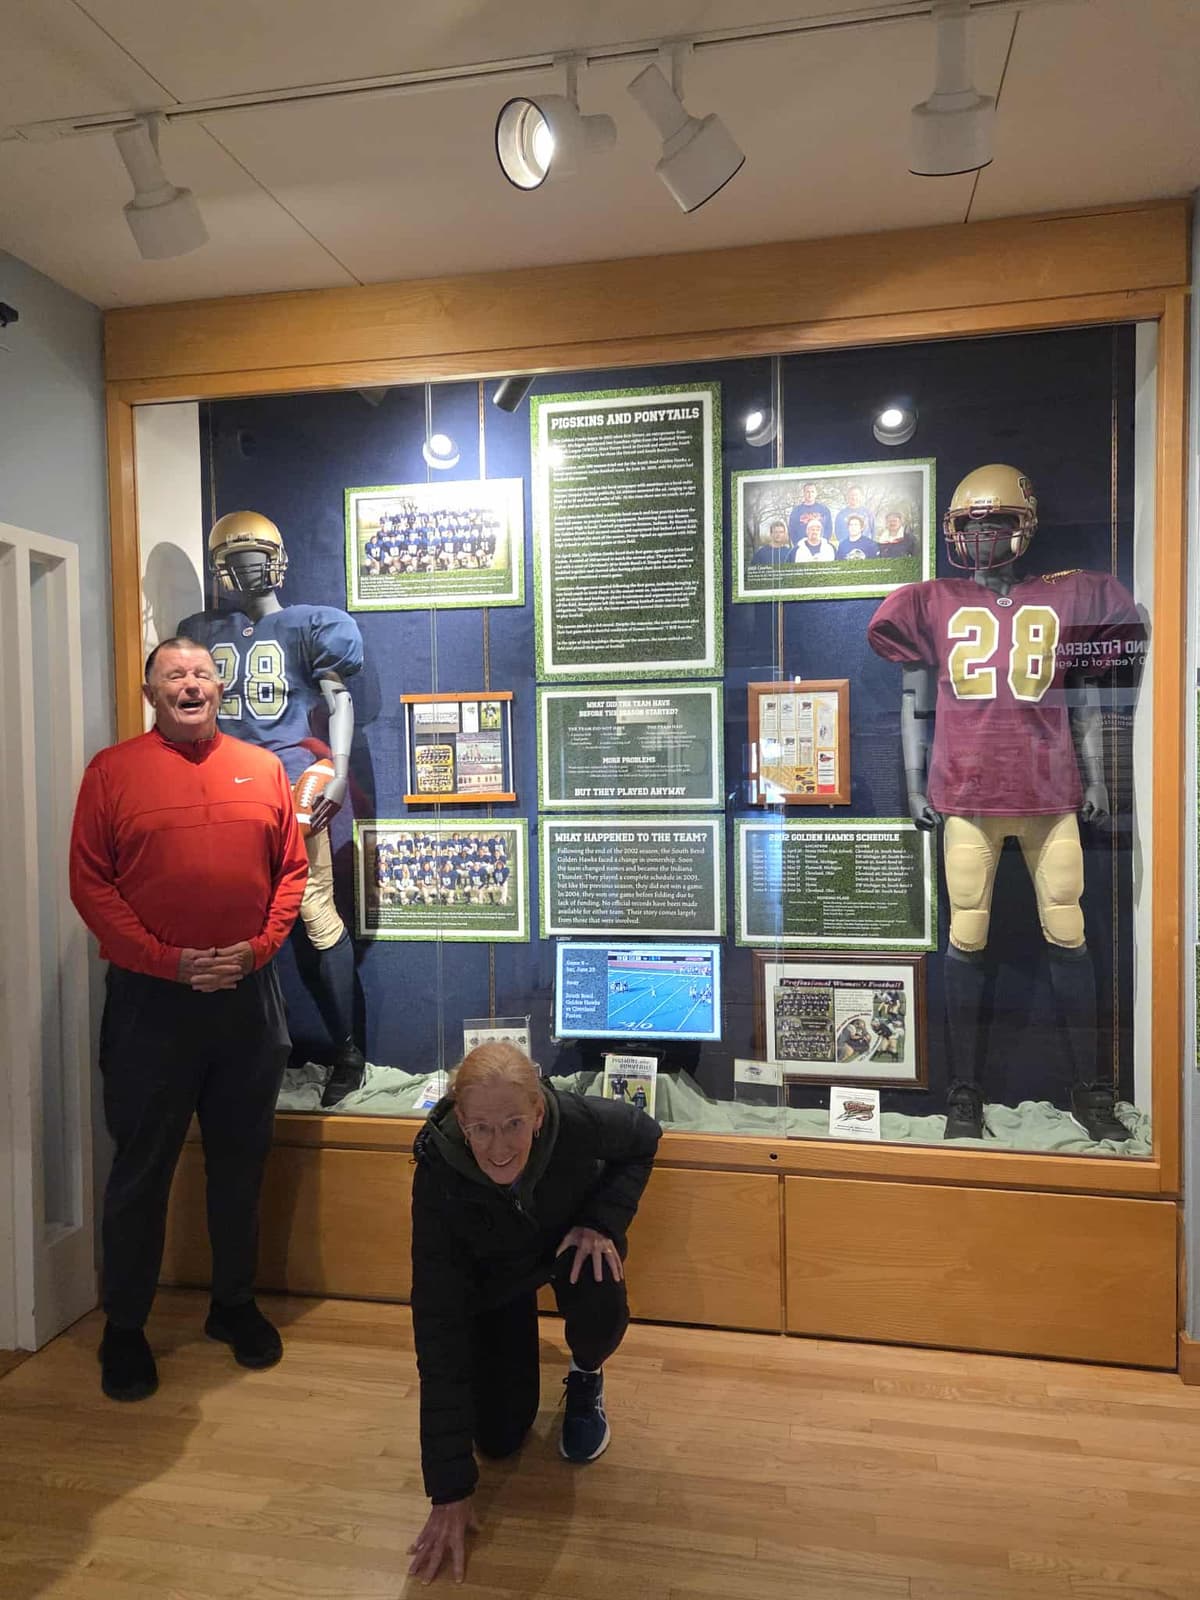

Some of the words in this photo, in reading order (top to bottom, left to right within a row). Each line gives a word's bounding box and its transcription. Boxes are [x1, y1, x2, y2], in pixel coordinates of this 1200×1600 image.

[551, 415, 604, 430] PIGSKINS
[606, 413, 631, 426] AND
[634, 408, 700, 423] PONYTAILS
[948, 605, 1060, 702] 28
[210, 640, 289, 720] 28
[617, 788, 648, 796] PLAYED
[650, 787, 686, 795] ANYWAY
[555, 833, 582, 842] WHAT
[584, 833, 634, 842] HAPPENED
[636, 833, 649, 842] TO
[651, 833, 671, 842] THE
[673, 833, 708, 842] TEAM?
[585, 874, 599, 882] They
[636, 882, 648, 890] they
